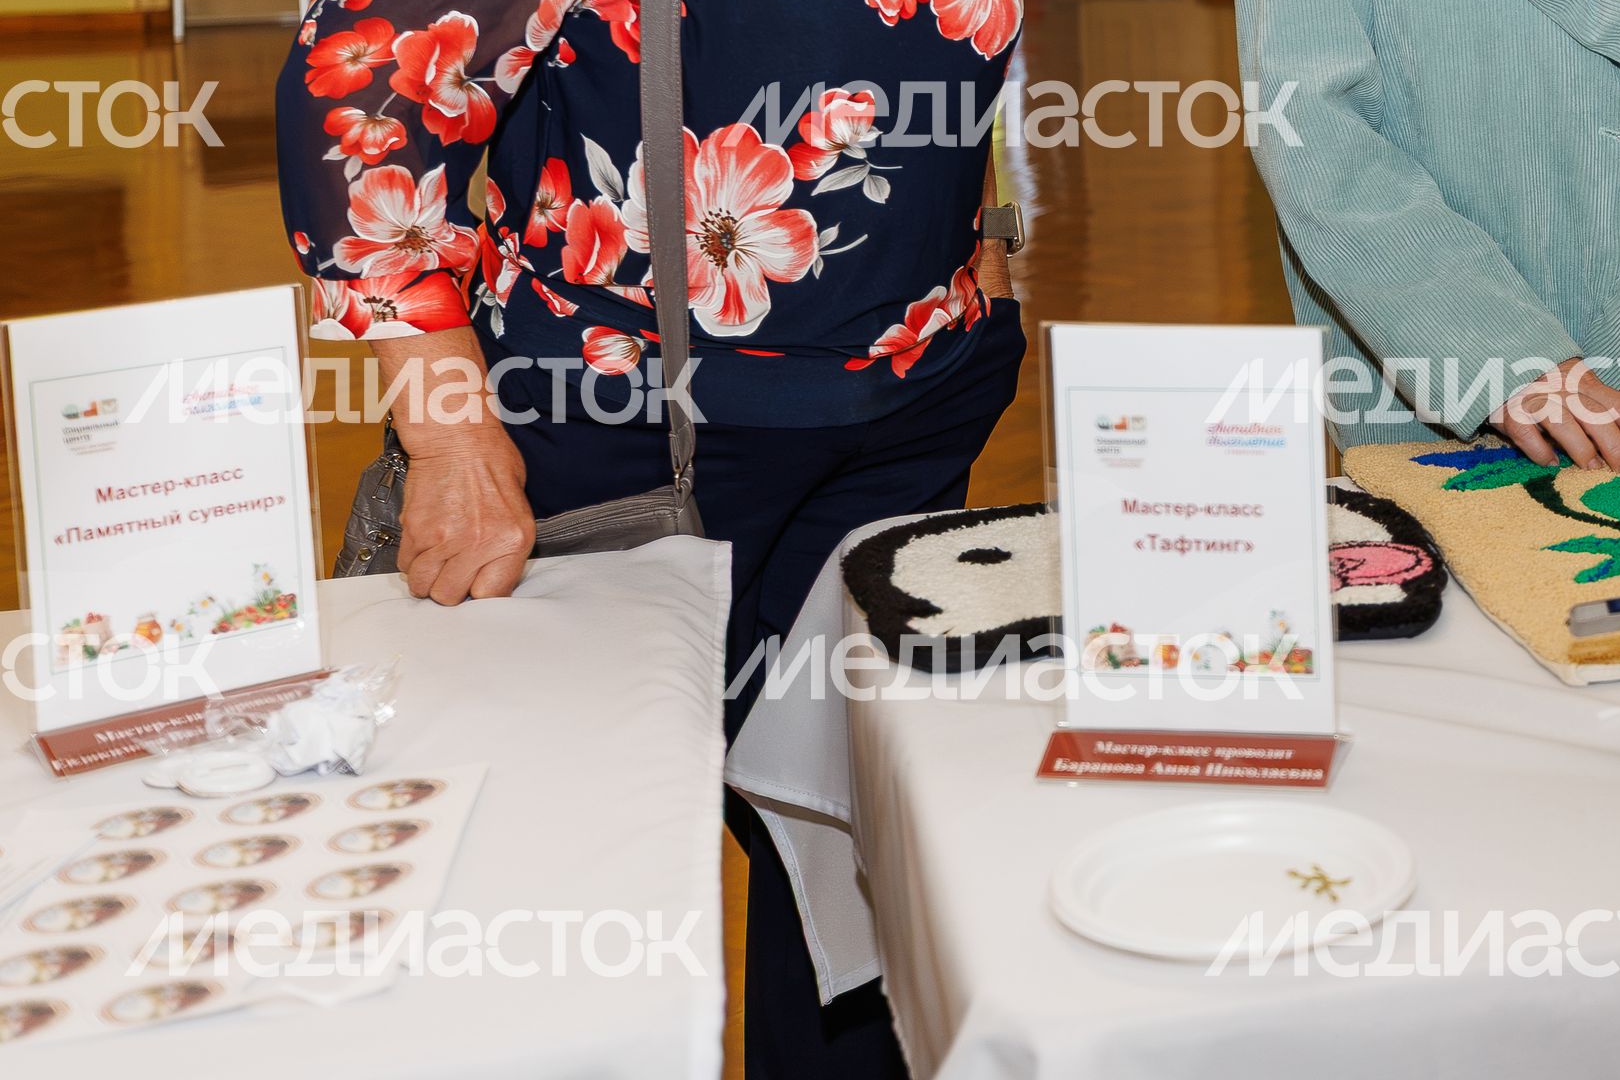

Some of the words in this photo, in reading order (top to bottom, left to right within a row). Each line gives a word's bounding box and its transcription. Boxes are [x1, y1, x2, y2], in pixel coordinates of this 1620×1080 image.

[95, 467, 245, 505] Мастер-класс
[1121, 498, 1264, 518] Мастер-класс
[53, 510, 182, 546] «Памятный
[188, 493, 287, 524] сувенир»
[1133, 533, 1256, 555] «Тафтинг»
[1094, 741, 1210, 758] Мастер-класс
[1214, 746, 1295, 761] проводит
[1054, 758, 1145, 775] Баранова
[1150, 760, 1201, 777] Анна
[1205, 762, 1323, 780] Николаевна
